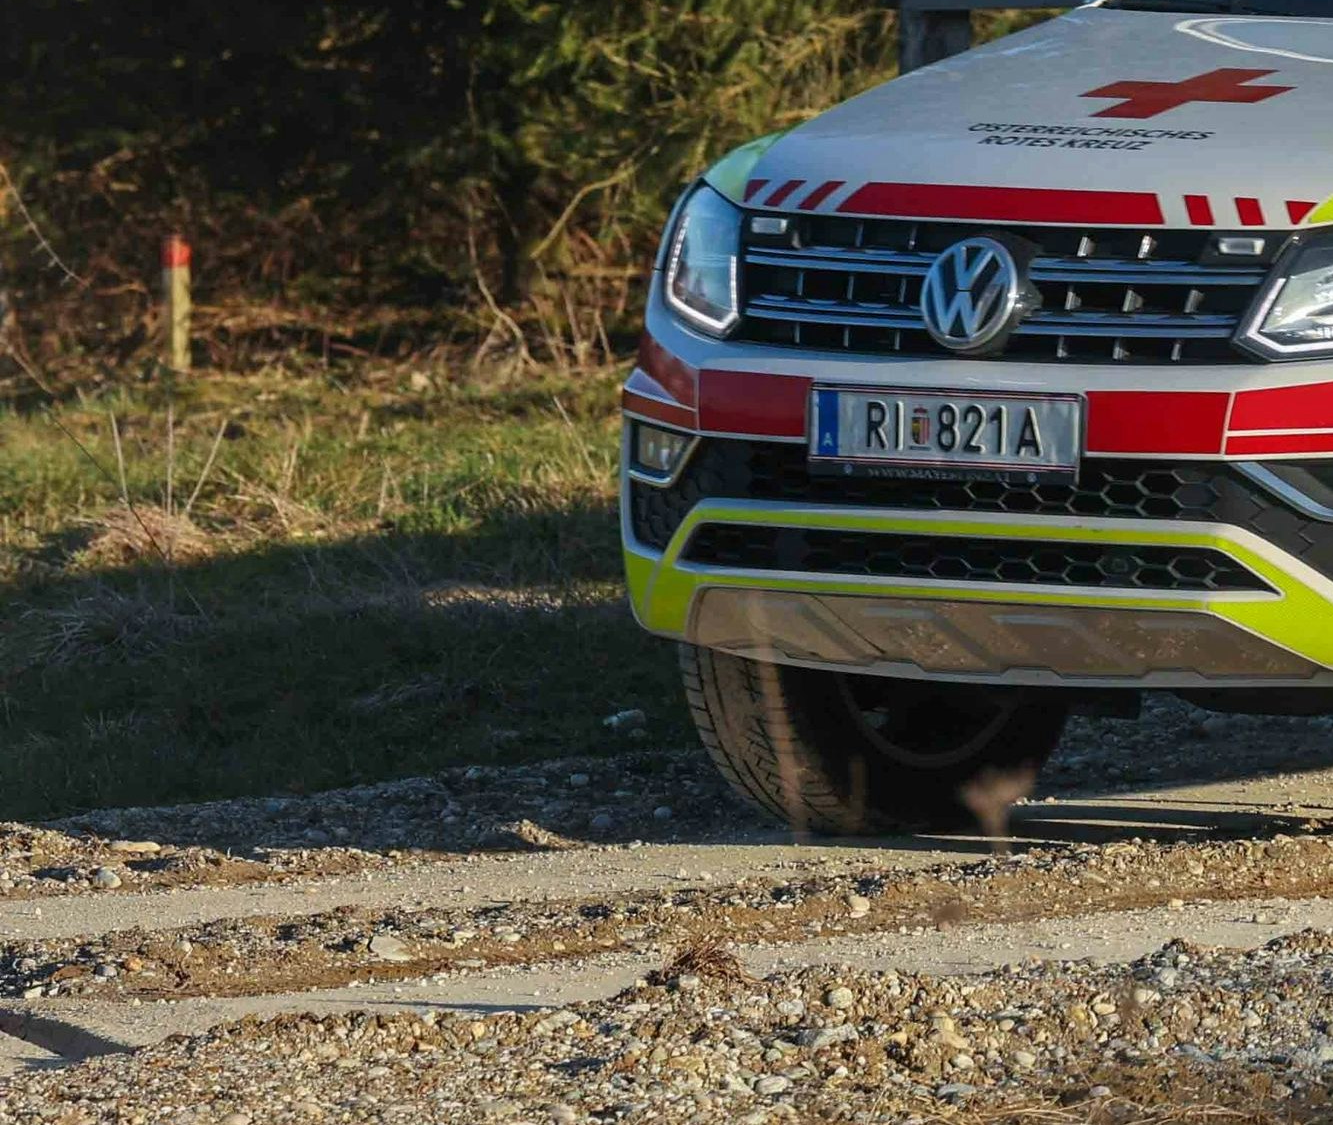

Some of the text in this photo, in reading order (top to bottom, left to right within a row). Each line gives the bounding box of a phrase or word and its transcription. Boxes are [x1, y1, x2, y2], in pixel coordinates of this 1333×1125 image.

[977, 134, 1152, 151] ROTES KREUZ
[866, 399, 1043, 457] RI 821A
